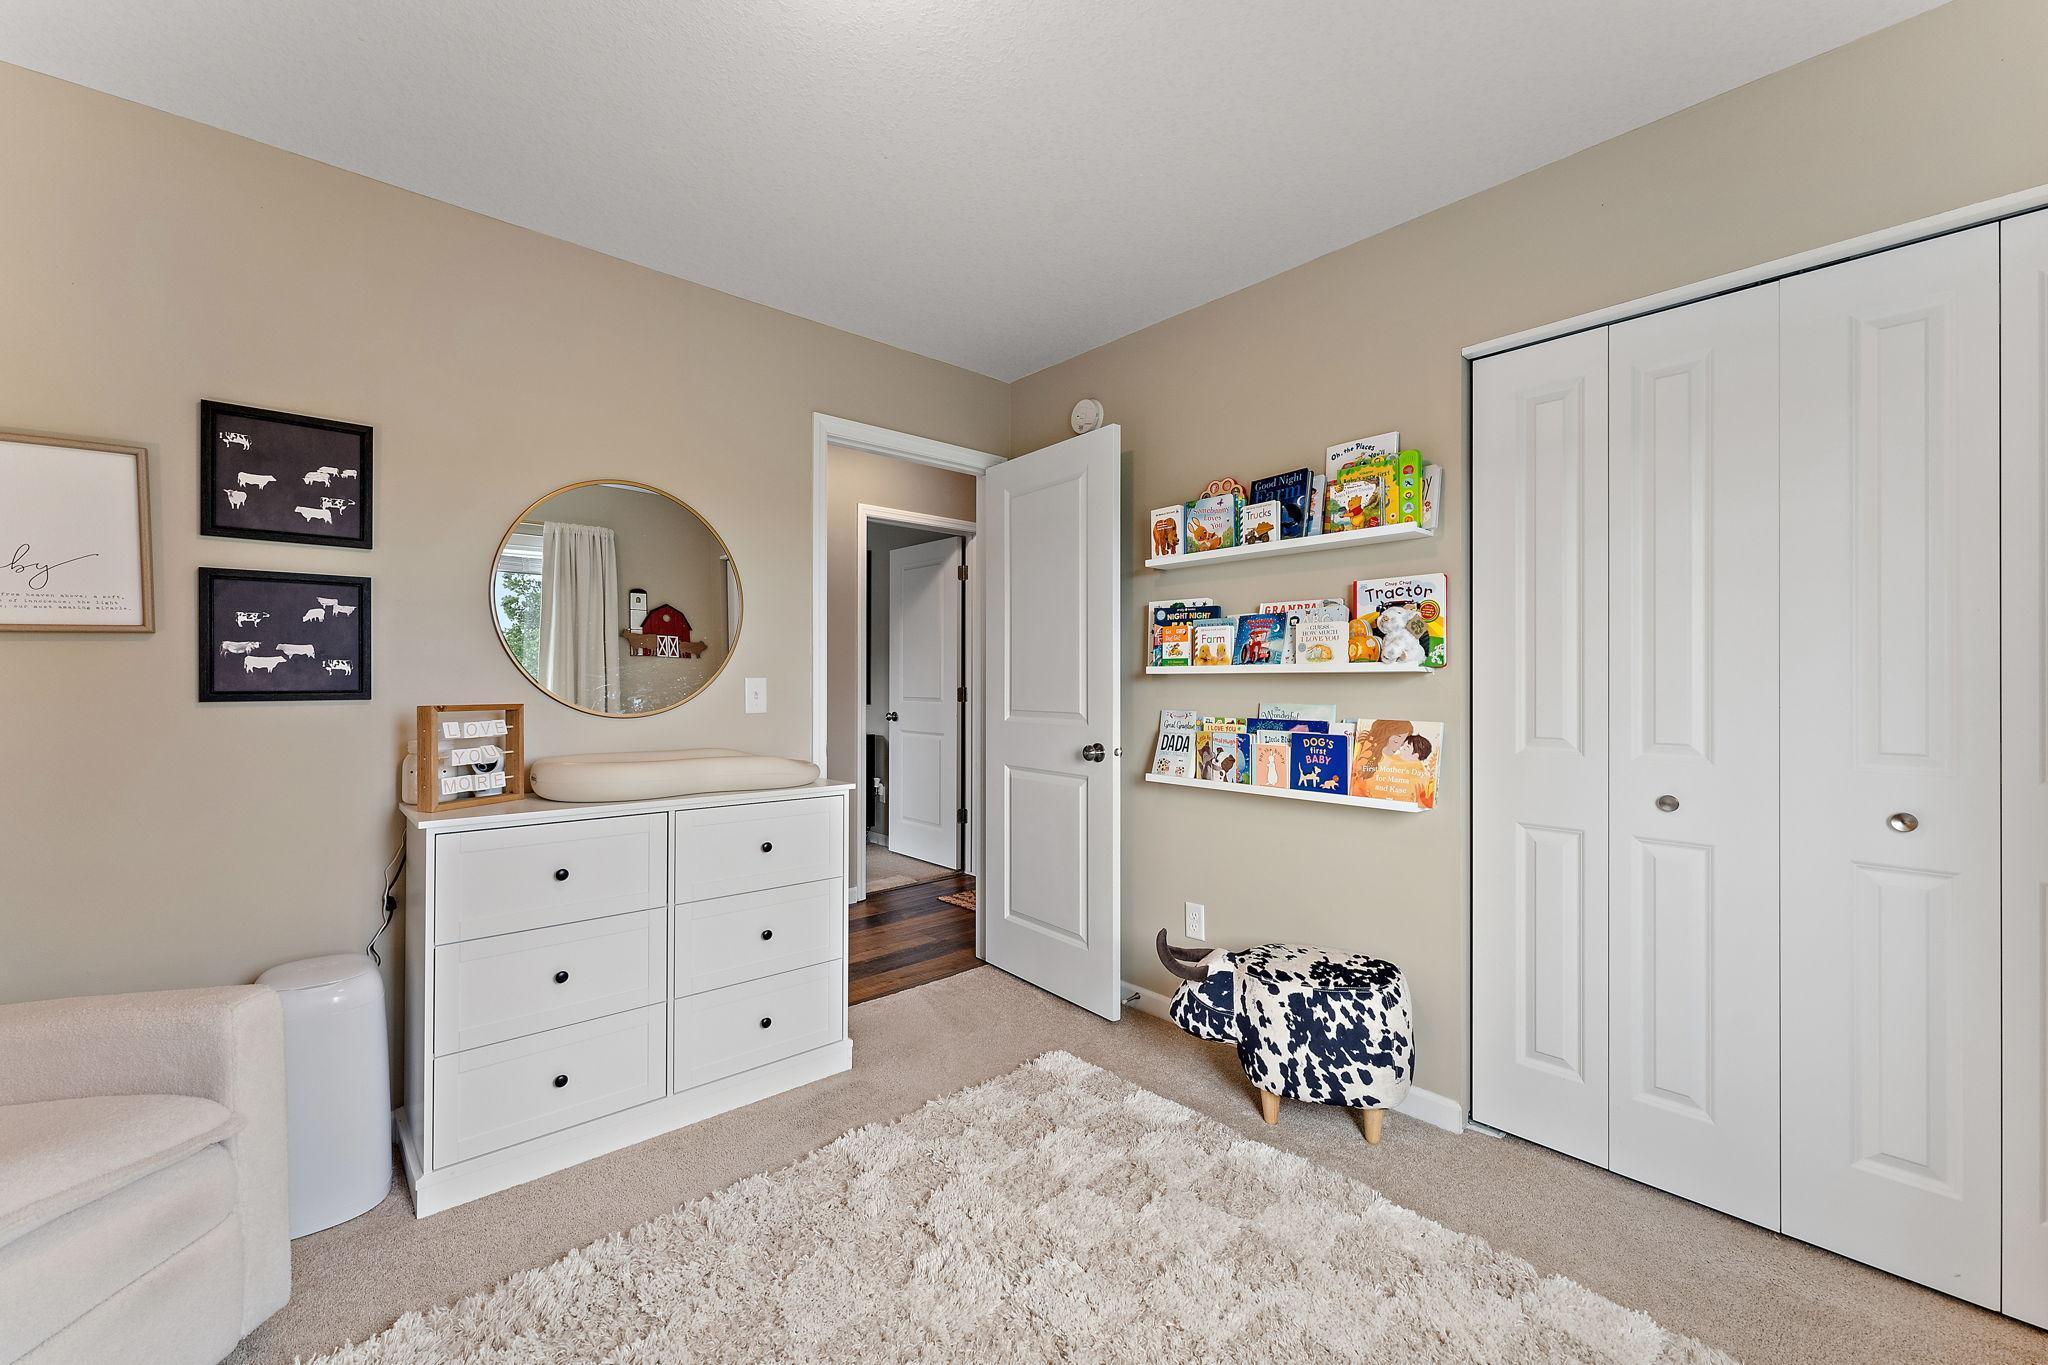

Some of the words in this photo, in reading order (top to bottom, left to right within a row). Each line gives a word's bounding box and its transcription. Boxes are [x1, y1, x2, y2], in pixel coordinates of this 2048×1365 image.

[1331, 452, 1343, 460] Oh,
[1355, 443, 1375, 451] Places
[1255, 478, 1277, 492] Good
[1279, 472, 1302, 486] Night
[1255, 484, 1301, 501] Farm
[1246, 508, 1272, 521] Trucks
[1211, 522, 1223, 530] You
[0, 543, 99, 590] by
[1365, 585, 1433, 602] Tractor
[1167, 612, 1188, 620] NIGHT
[1201, 634, 1225, 644] Farm
[1261, 709, 1300, 720] Wonderful
[447, 721, 505, 737] LOVE
[1160, 734, 1190, 753] DADA
[1281, 735, 1291, 743] Blu
[1303, 738, 1334, 749] DOG'S
[455, 746, 497, 764] YOU
[1310, 747, 1327, 755] first
[1305, 755, 1332, 765] BABY
[1380, 766, 1409, 775] Mother's
[1411, 768, 1425, 777] Day
[444, 773, 505, 793] MORE
[1388, 776, 1409, 784] Mama
